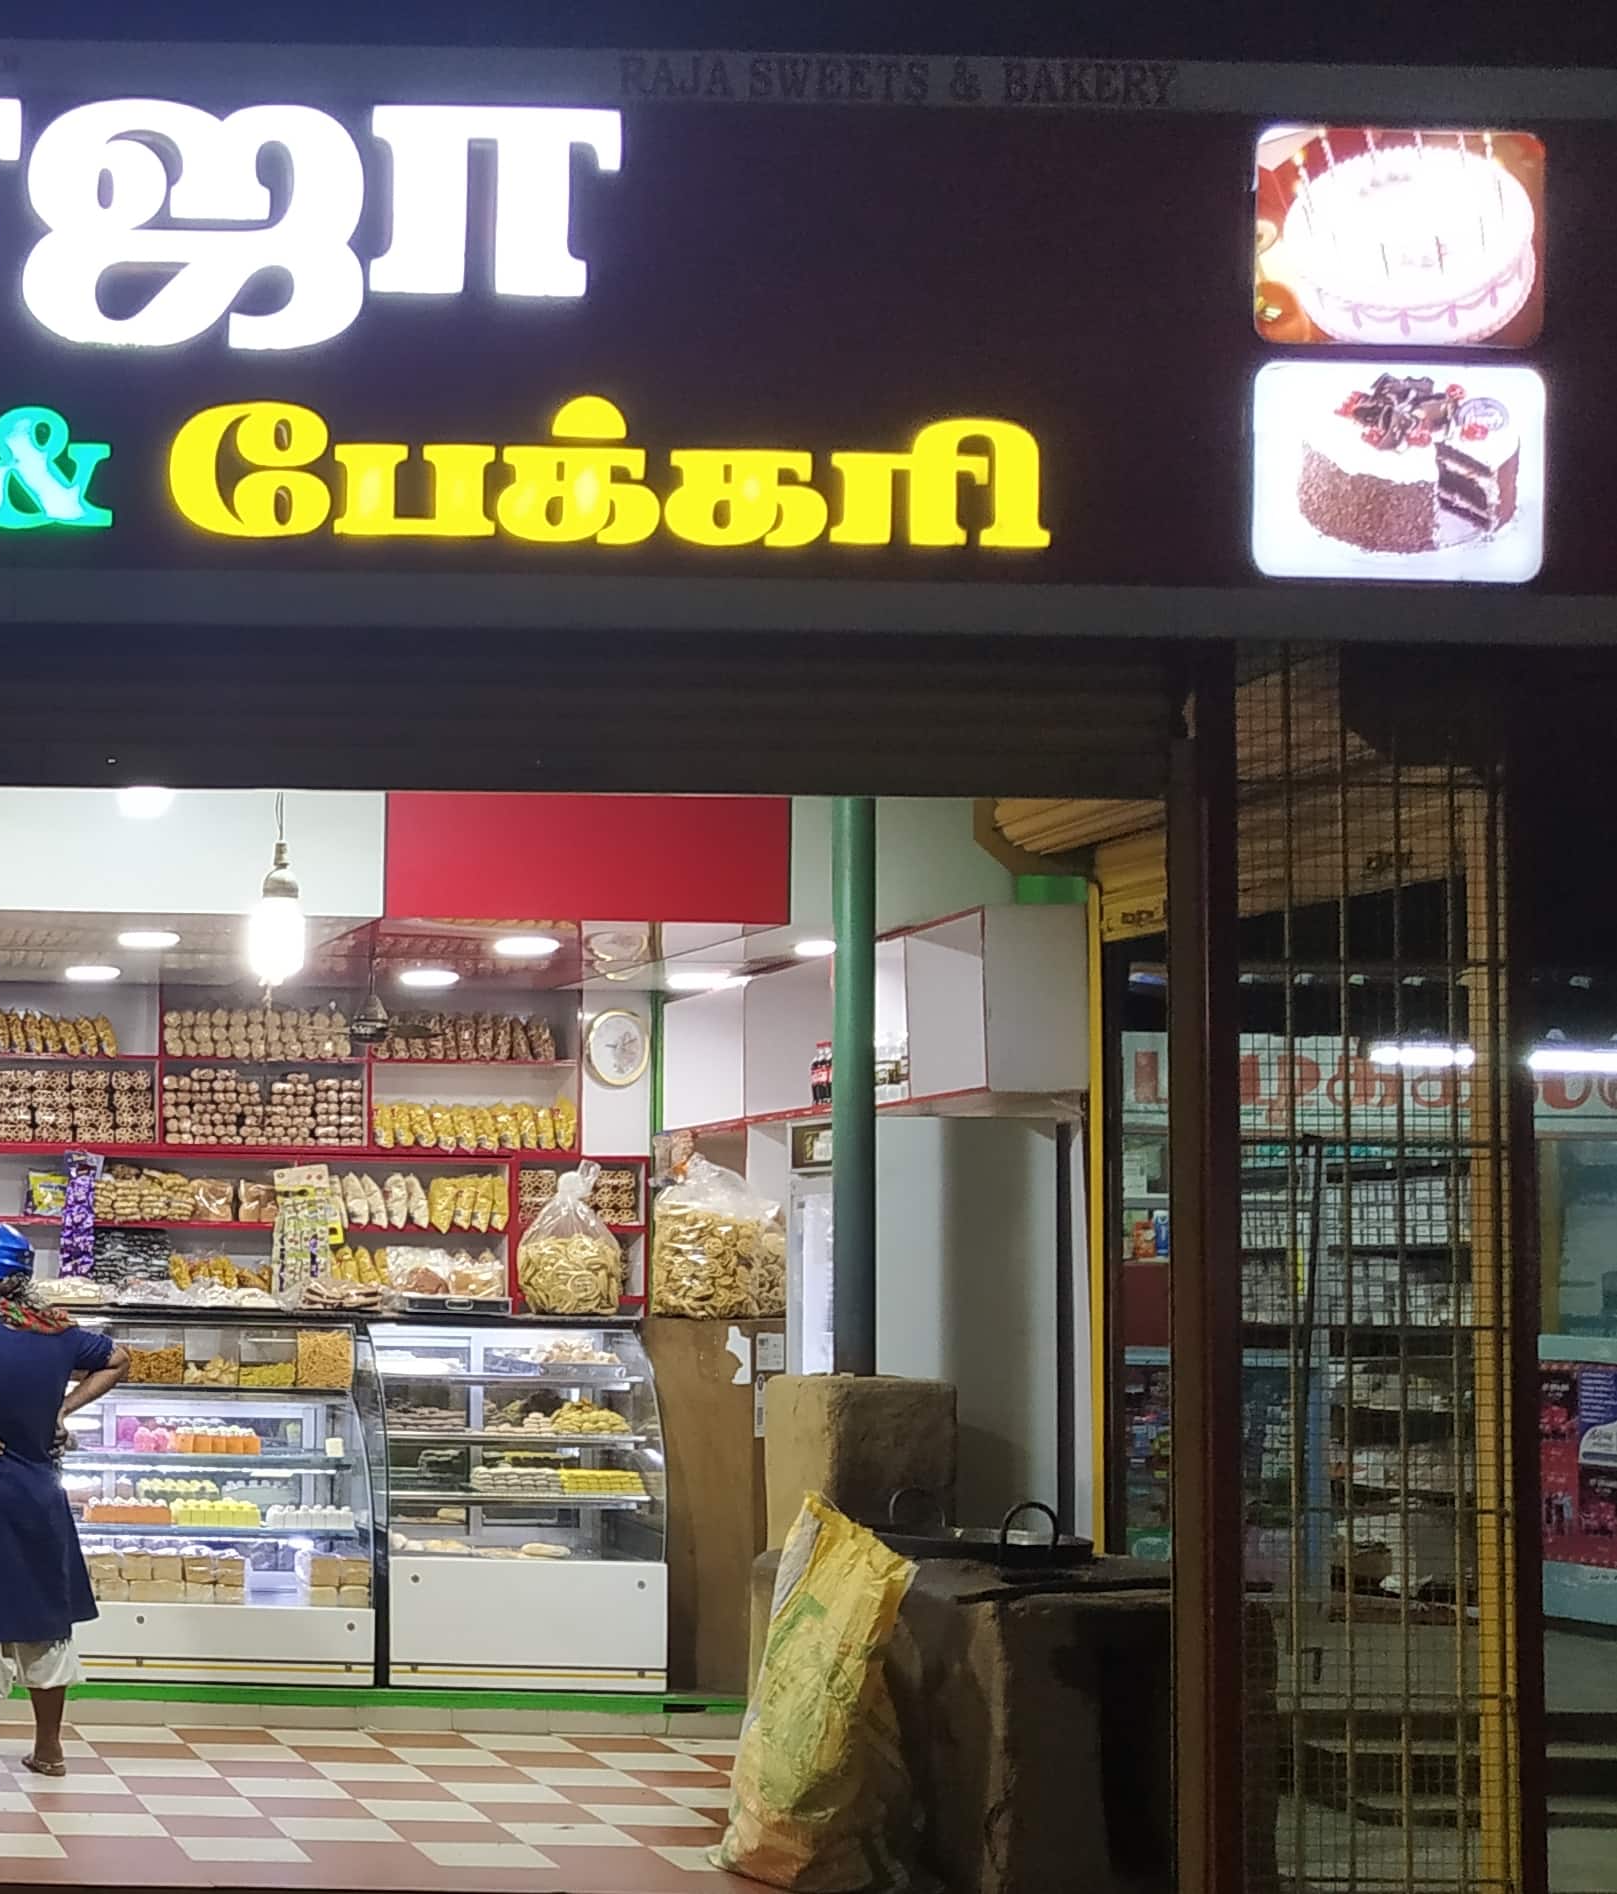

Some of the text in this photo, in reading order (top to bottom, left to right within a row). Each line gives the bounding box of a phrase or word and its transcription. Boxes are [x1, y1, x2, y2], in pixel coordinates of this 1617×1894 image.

[620, 56, 1177, 105] RAJA SWEETS & BAKERY
[169, 396, 1051, 549] பேக்கரி
